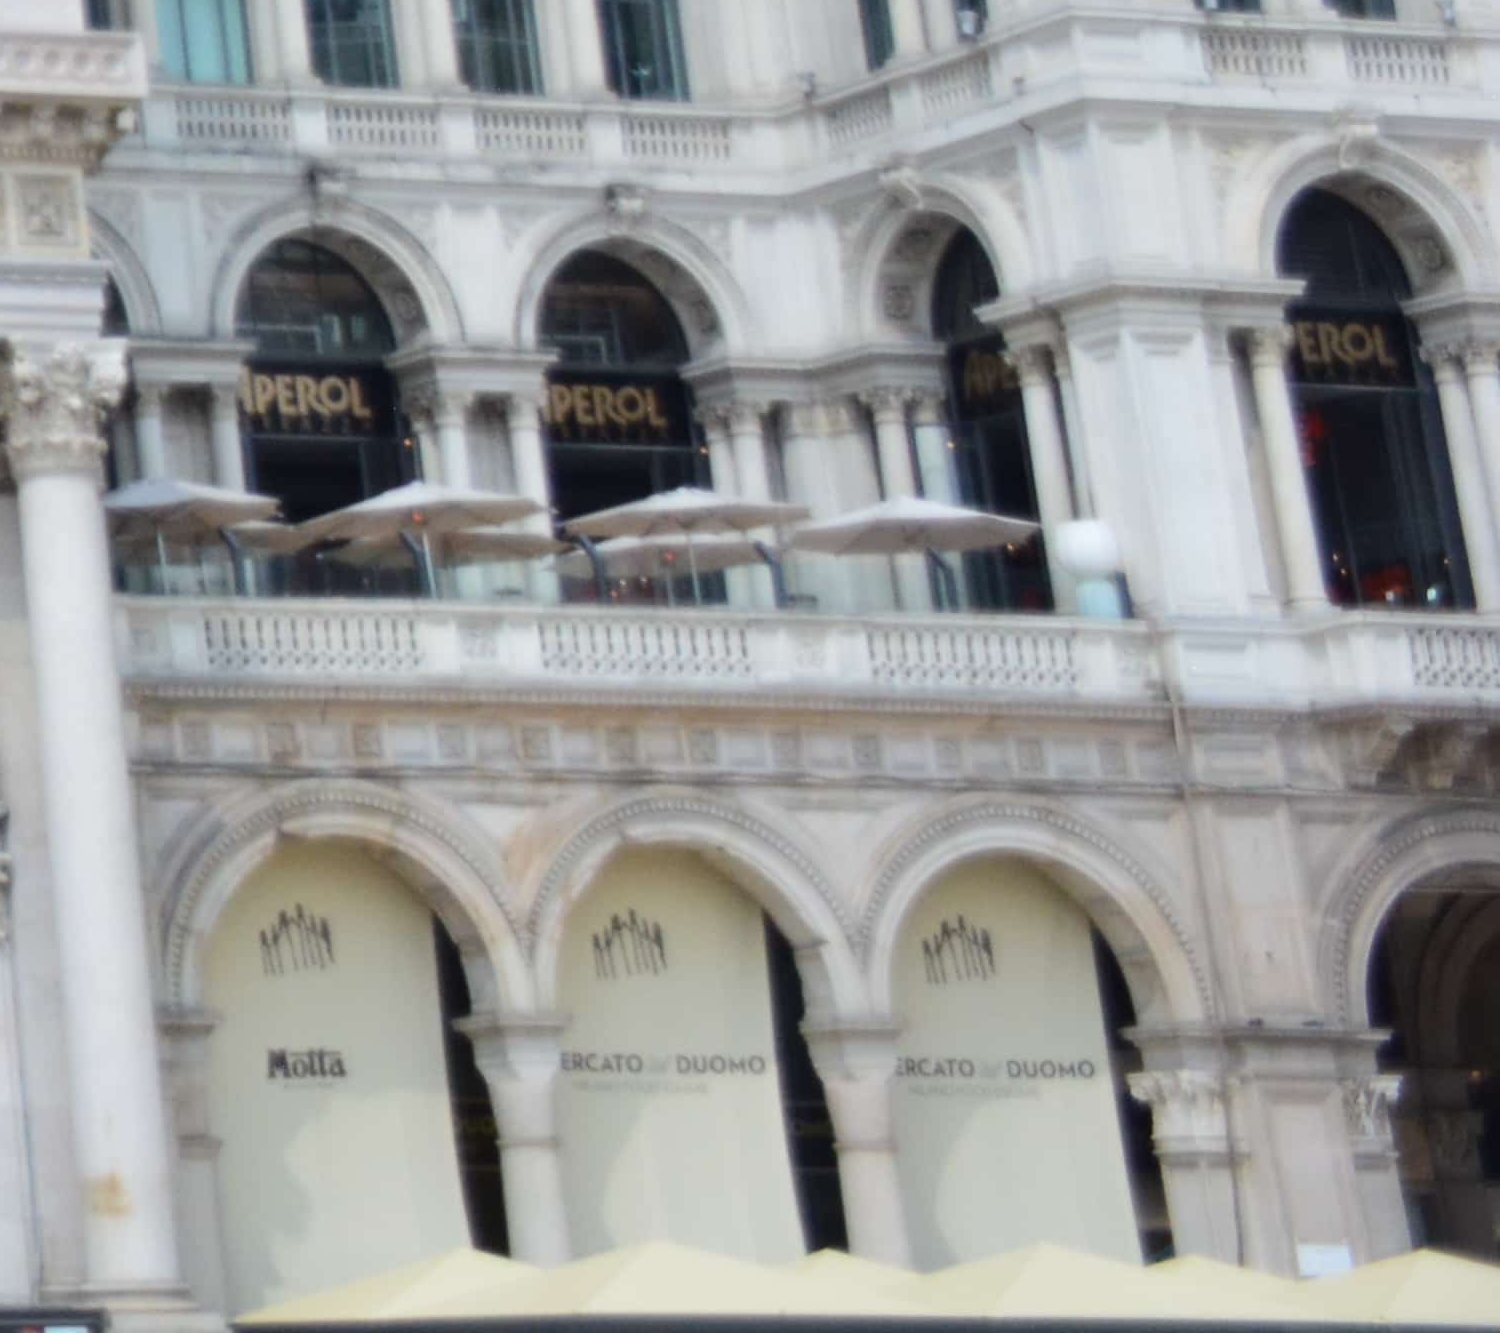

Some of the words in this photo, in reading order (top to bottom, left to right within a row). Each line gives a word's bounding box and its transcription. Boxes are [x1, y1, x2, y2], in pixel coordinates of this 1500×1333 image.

[267, 1048, 347, 1078] Motta
[559, 1051, 643, 1074] ERCATO
[673, 1053, 763, 1075] DUOMO
[1005, 1059, 1096, 1079] DUOMO
